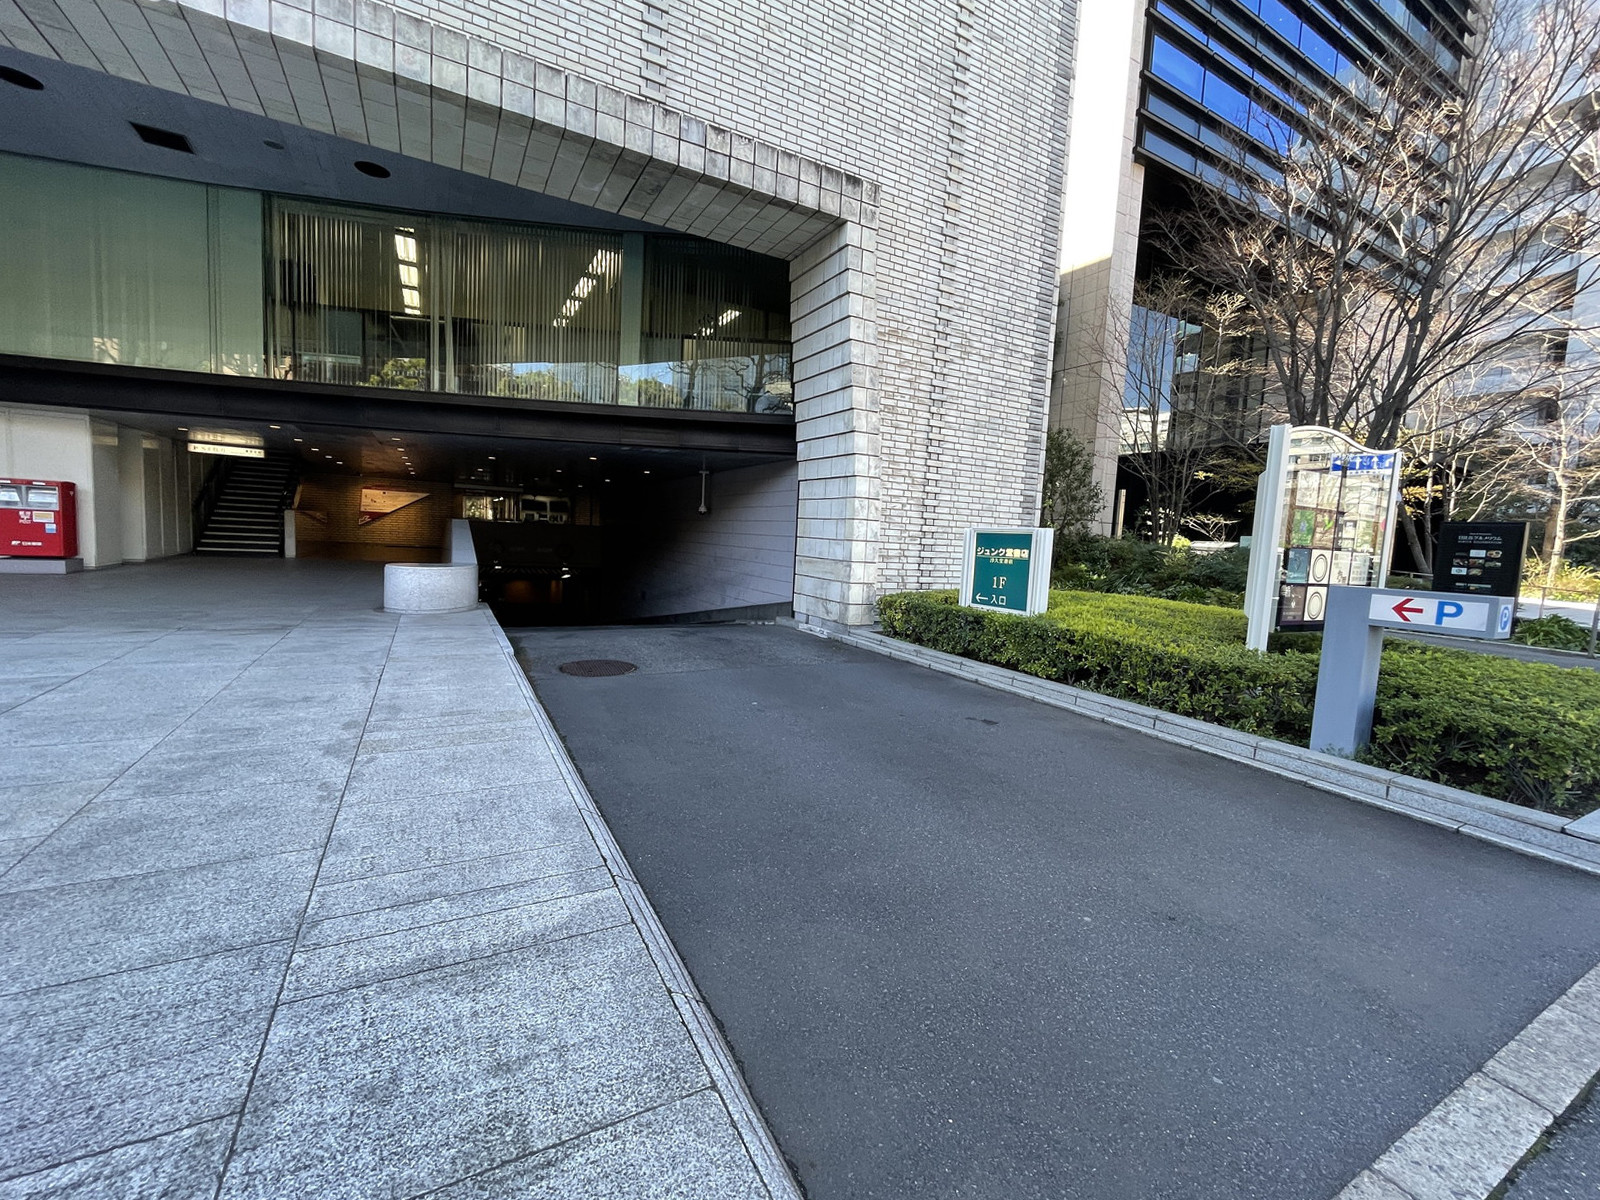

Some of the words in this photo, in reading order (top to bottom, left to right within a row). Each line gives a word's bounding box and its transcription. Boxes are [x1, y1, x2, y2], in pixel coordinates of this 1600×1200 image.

[976, 547, 1029, 558] ジュンク堂書店
[992, 576, 1007, 589] 1F
[990, 594, 1006, 605] 入口
[1435, 600, 1464, 626] P
